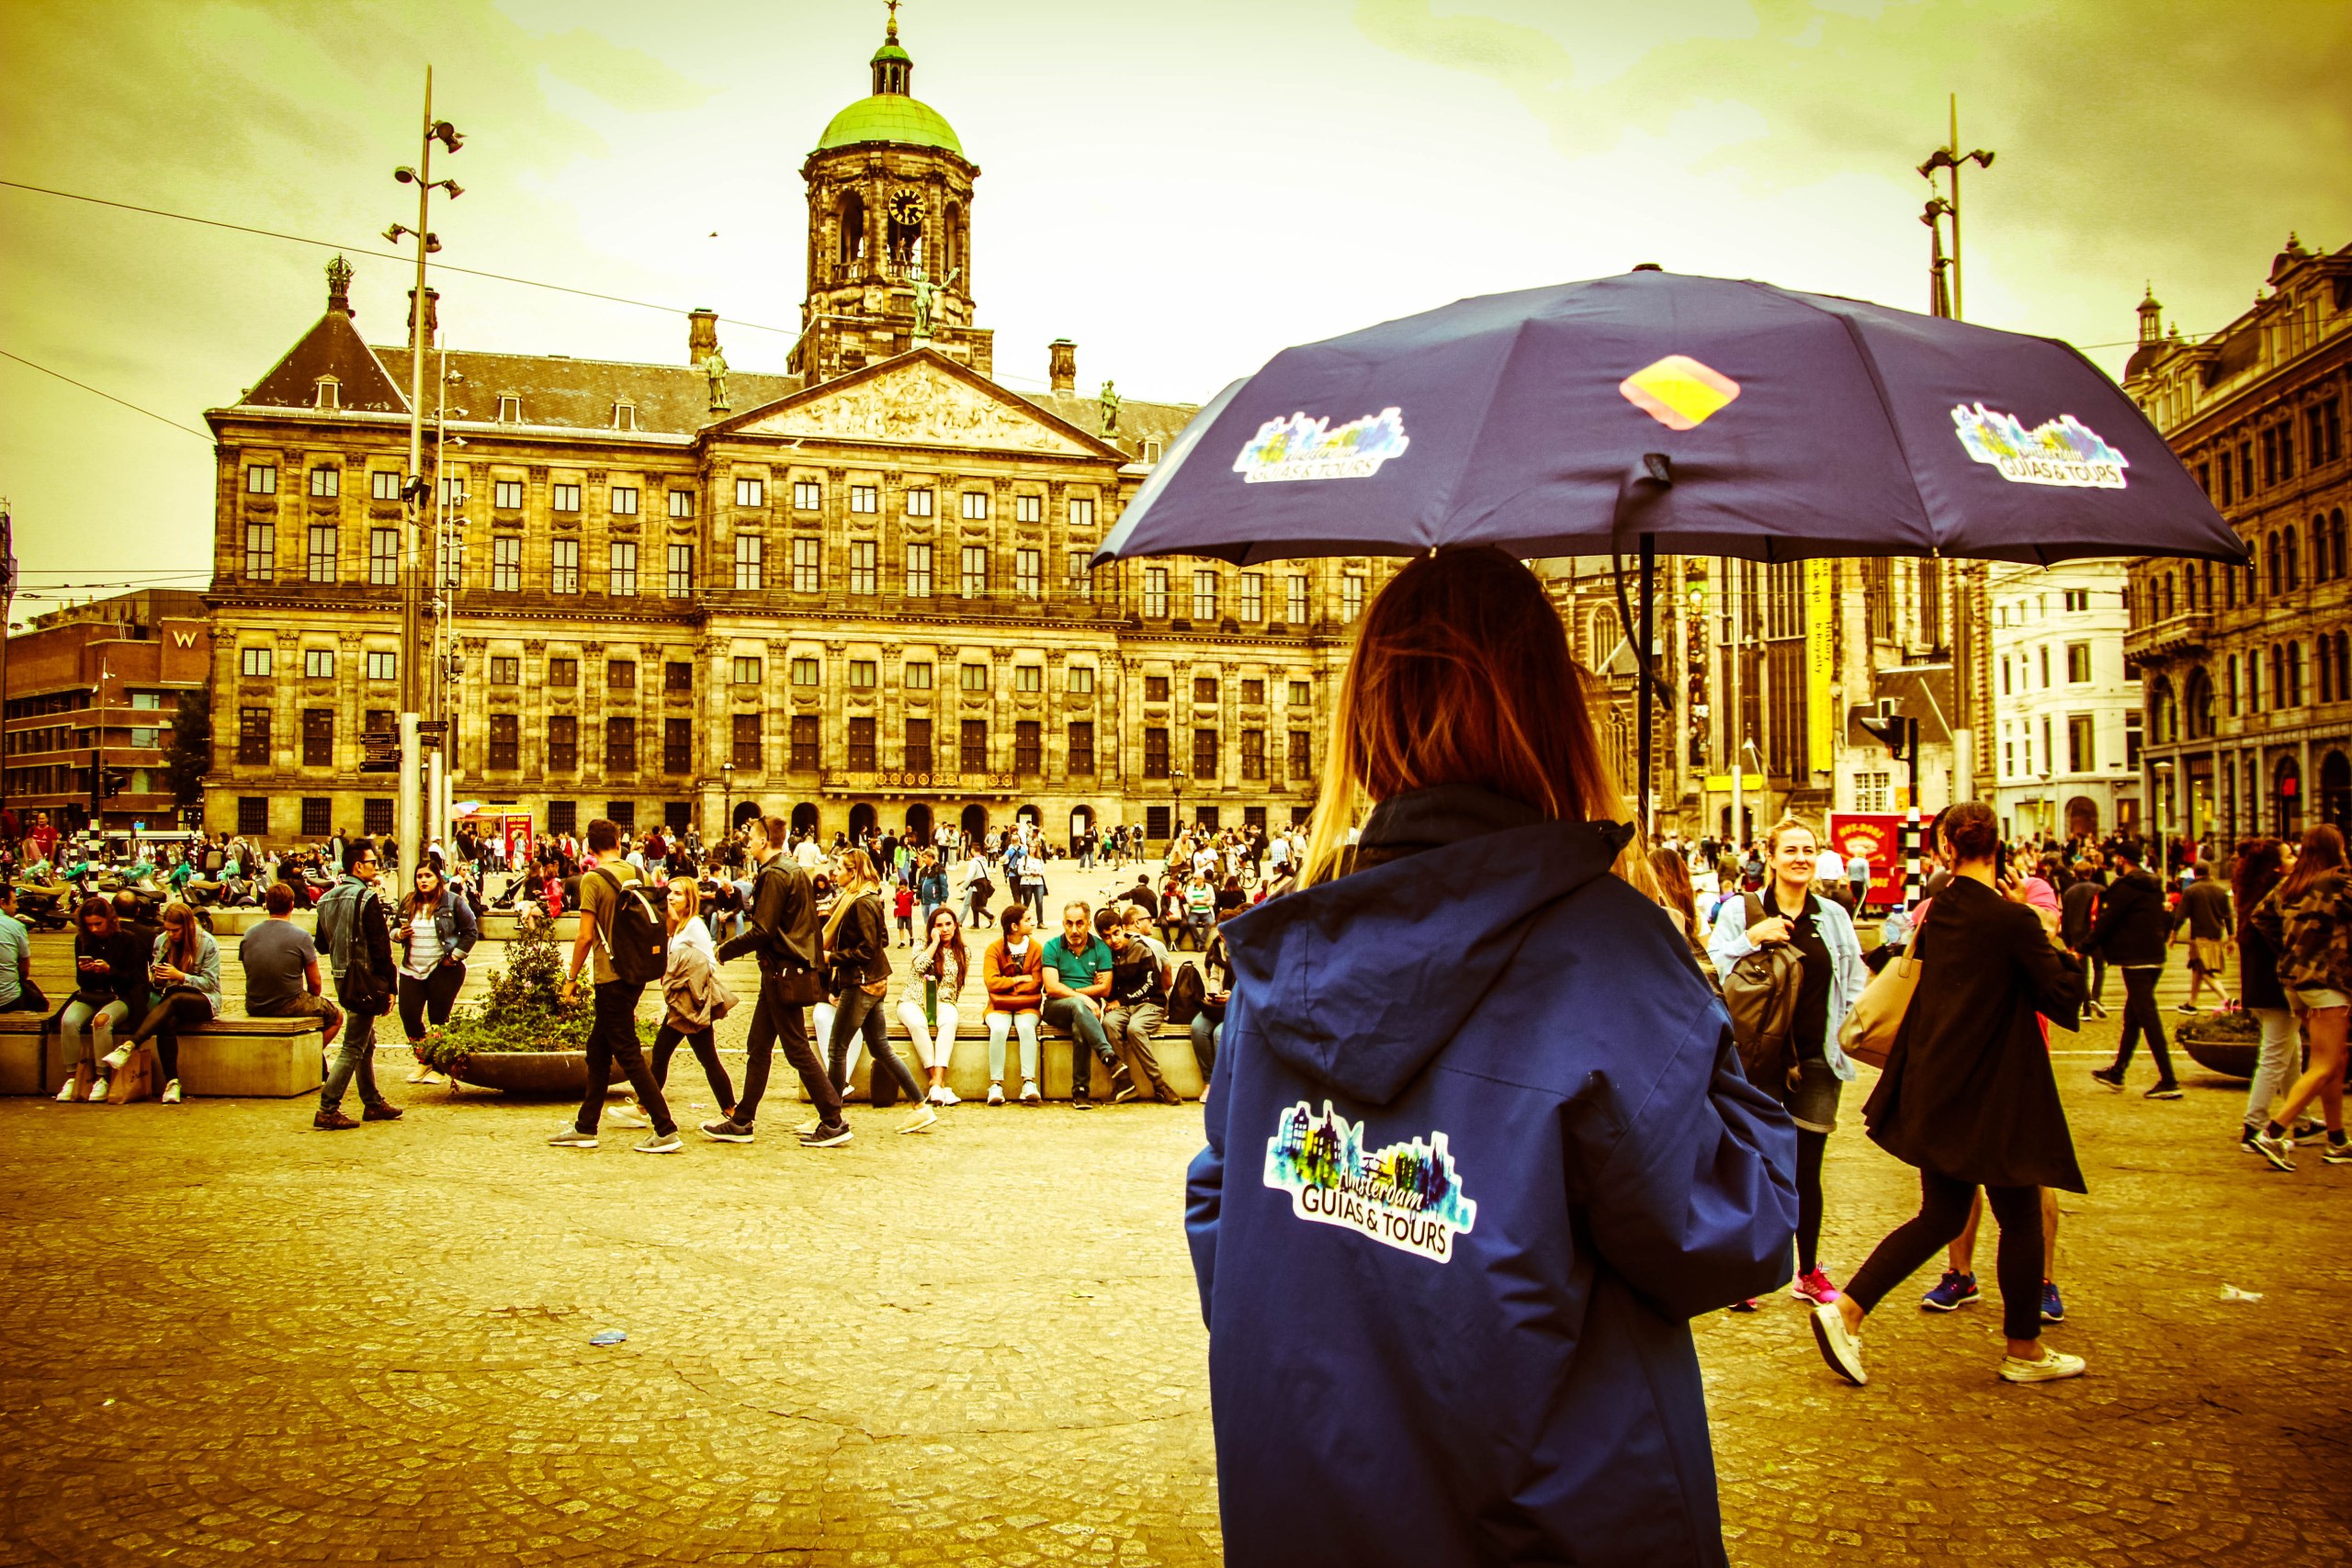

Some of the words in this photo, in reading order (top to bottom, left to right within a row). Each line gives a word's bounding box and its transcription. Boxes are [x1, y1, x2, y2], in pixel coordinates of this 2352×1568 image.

[2053, 465, 2066, 479] &
[2065, 464, 2119, 483] TOURS
[172, 630, 198, 649] W
[1338, 1165, 1425, 1212] Amsterdam
[1367, 1208, 1378, 1233] &
[1383, 1213, 1446, 1255] TOURS
